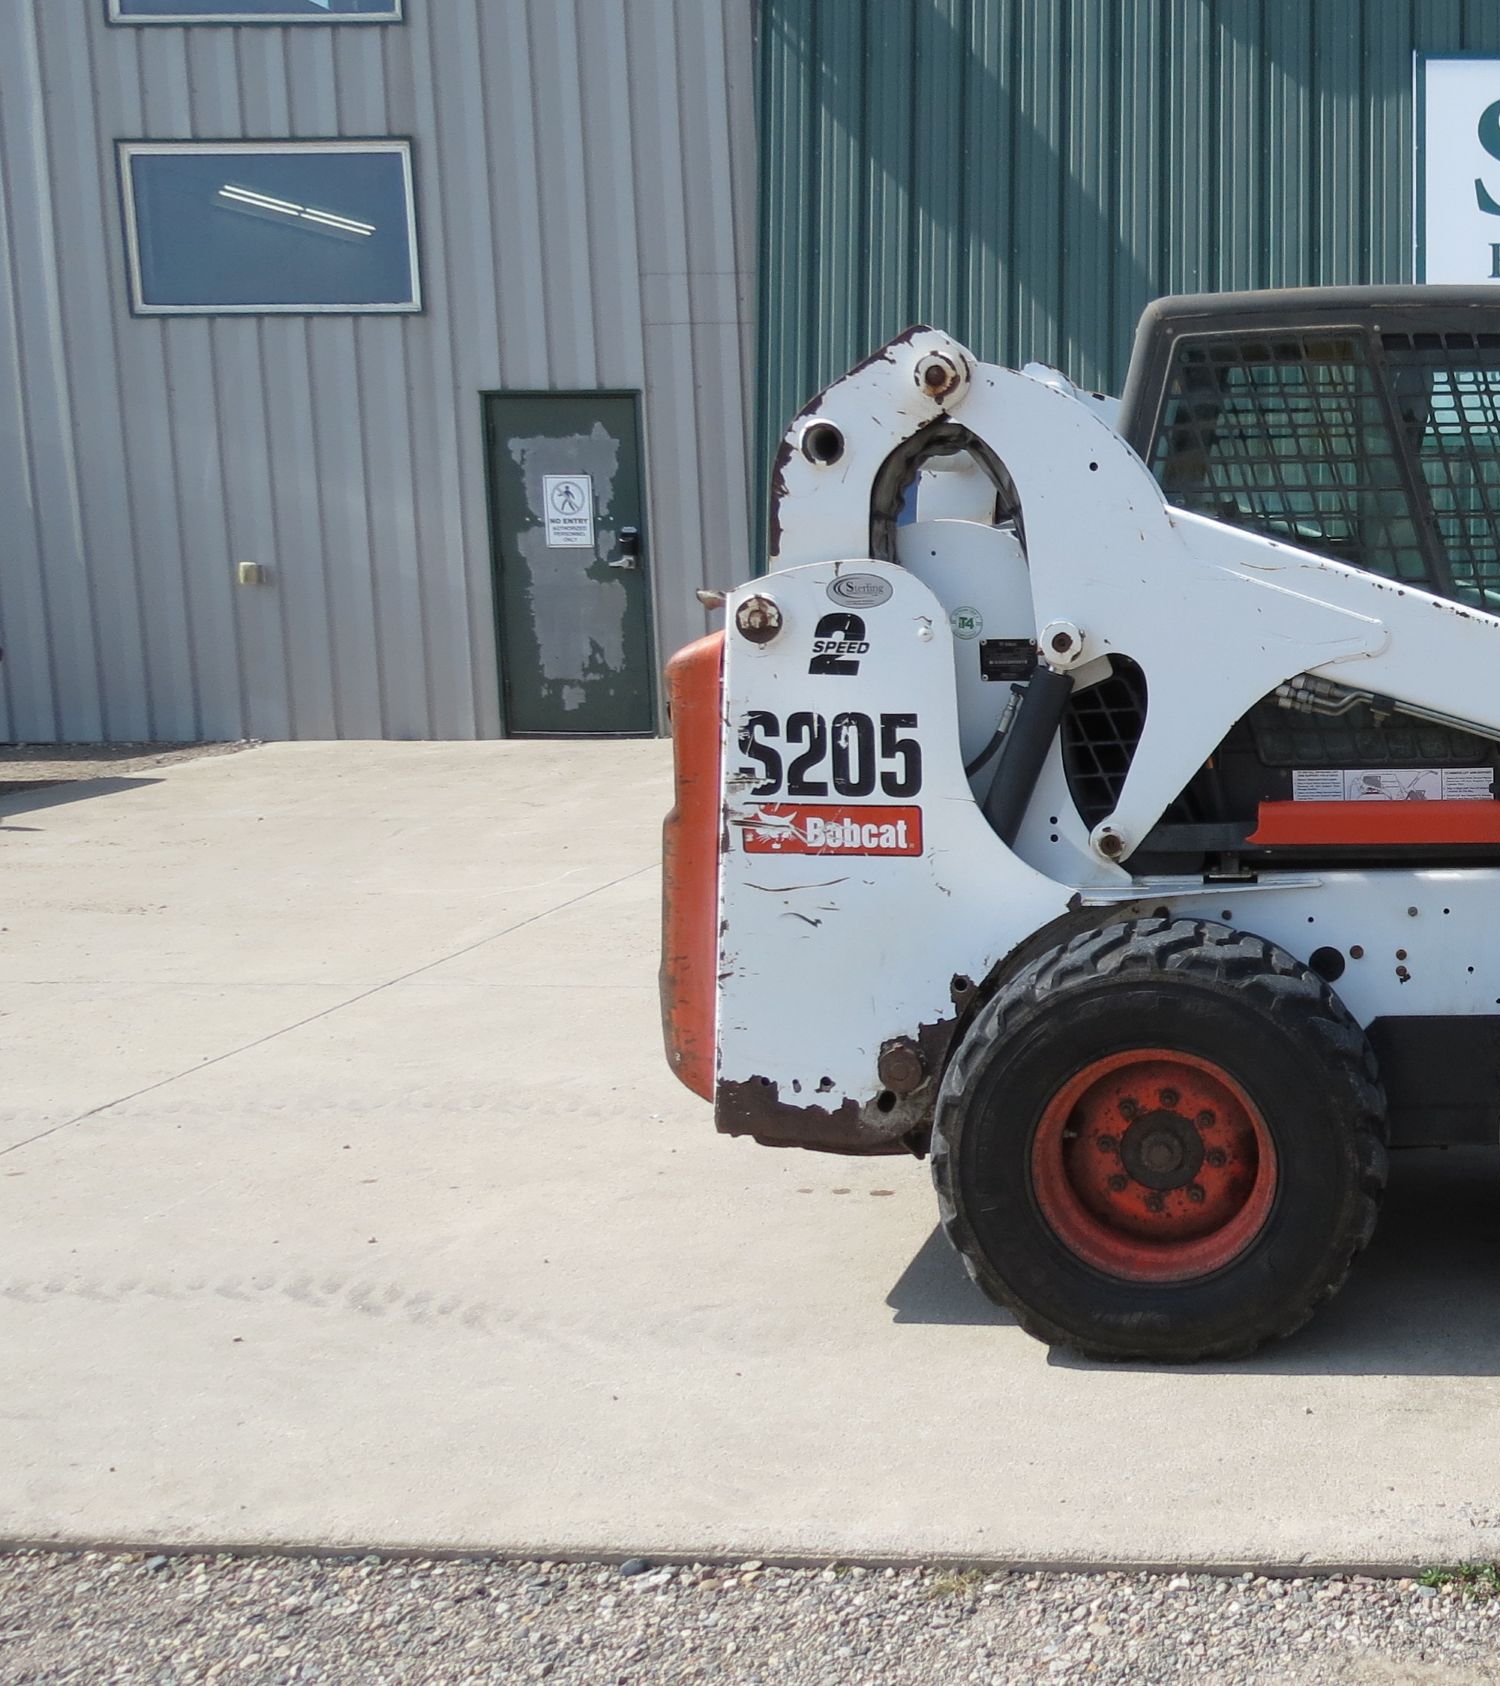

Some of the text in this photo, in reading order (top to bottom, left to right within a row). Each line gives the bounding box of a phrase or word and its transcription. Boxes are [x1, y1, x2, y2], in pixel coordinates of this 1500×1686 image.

[846, 581, 885, 594] Sterling
[808, 612, 866, 676] 2
[812, 640, 870, 655] SPEED
[738, 711, 923, 798] S205
[805, 816, 908, 849] Bobcat
